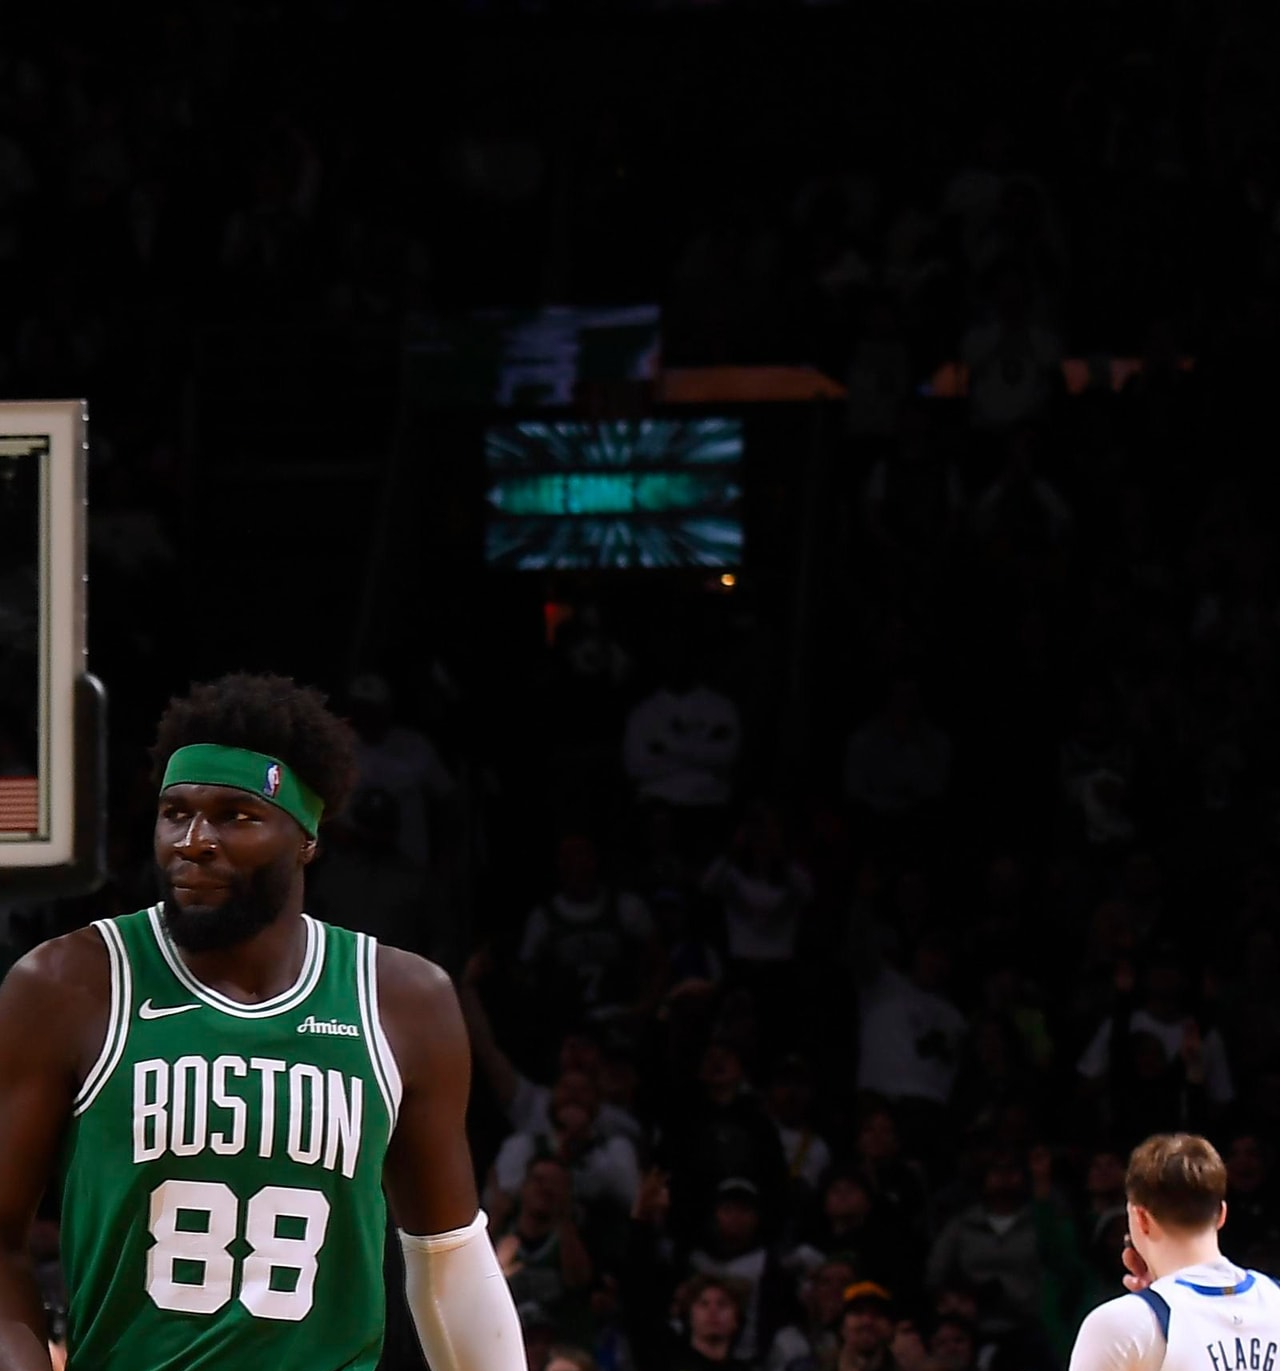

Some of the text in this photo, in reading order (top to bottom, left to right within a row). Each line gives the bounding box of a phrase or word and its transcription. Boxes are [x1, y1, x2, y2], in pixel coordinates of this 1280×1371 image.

[297, 1016, 360, 1038] Amica
[132, 1054, 364, 1179] BOSTON
[145, 1179, 331, 1322] 88
